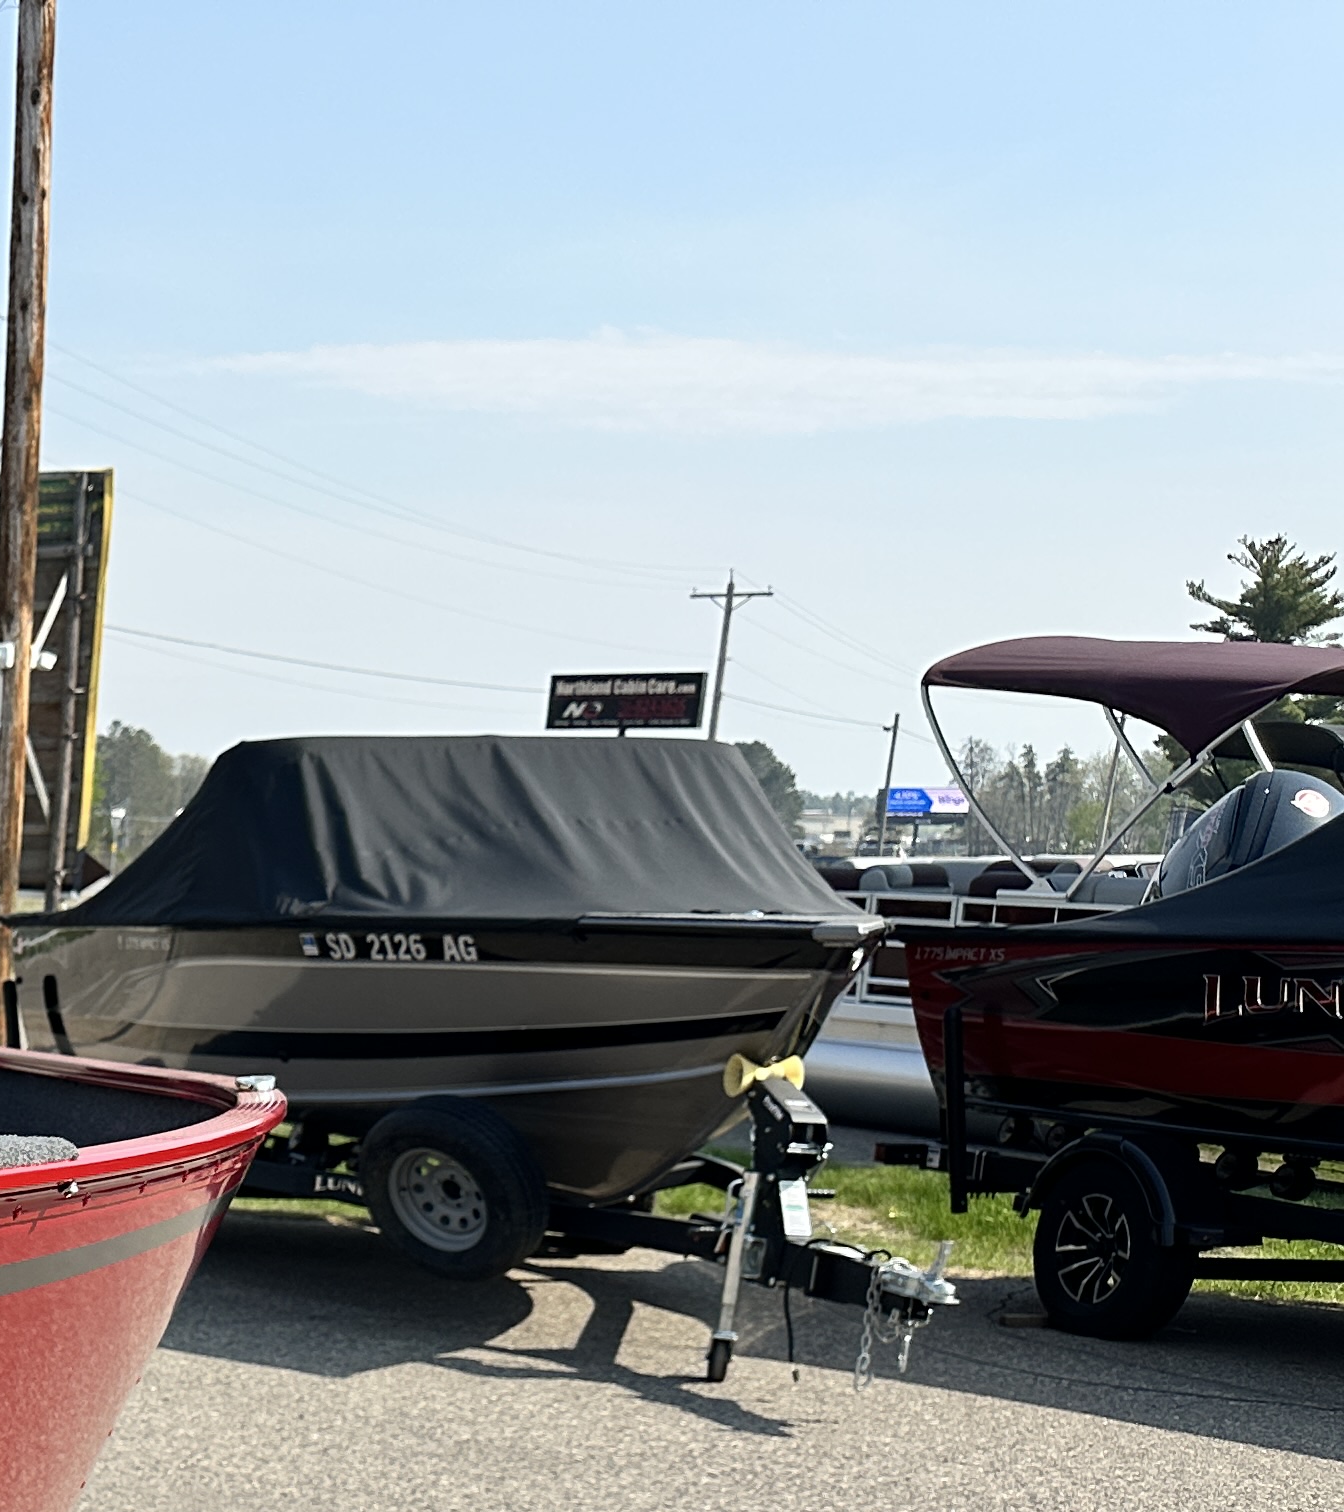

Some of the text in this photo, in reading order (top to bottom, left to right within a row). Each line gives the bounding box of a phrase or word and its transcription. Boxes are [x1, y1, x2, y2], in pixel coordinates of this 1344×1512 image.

[325, 932, 479, 962] SD 2126 AG
[988, 947, 1006, 961] XS
